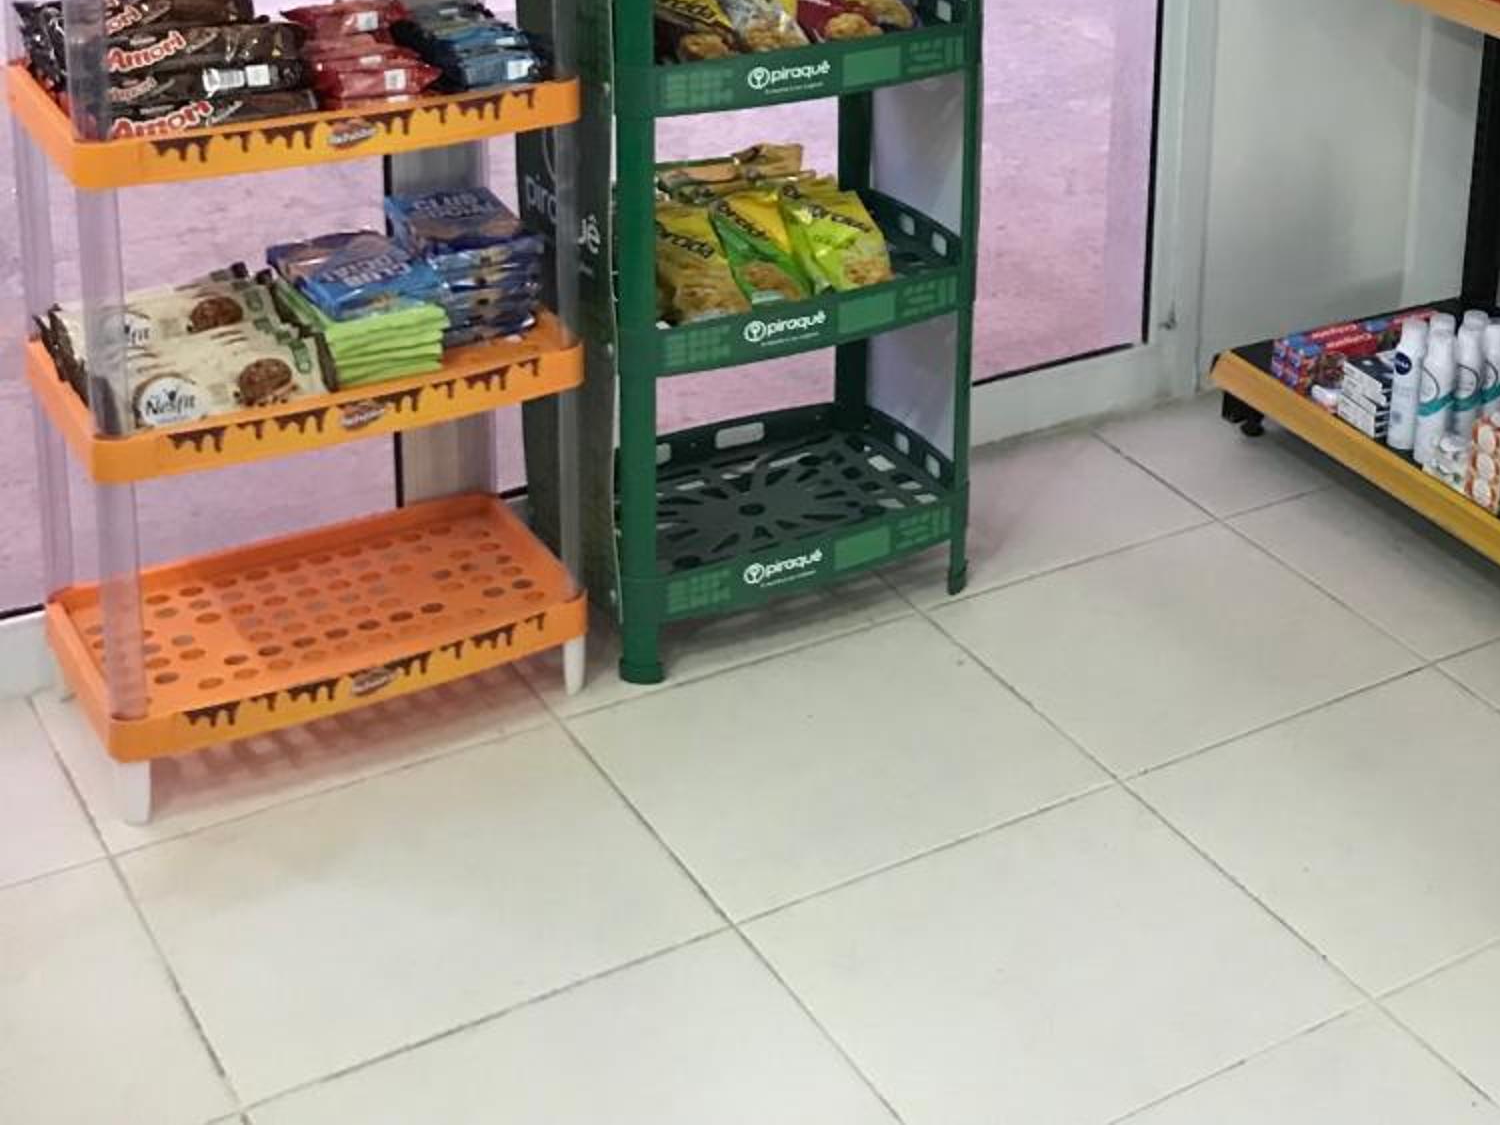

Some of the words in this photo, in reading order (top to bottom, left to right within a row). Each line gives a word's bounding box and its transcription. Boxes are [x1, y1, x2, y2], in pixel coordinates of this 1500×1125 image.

[770, 59, 831, 84] piraquê
[765, 310, 826, 338] piraquê
[763, 549, 823, 579] piraquê
